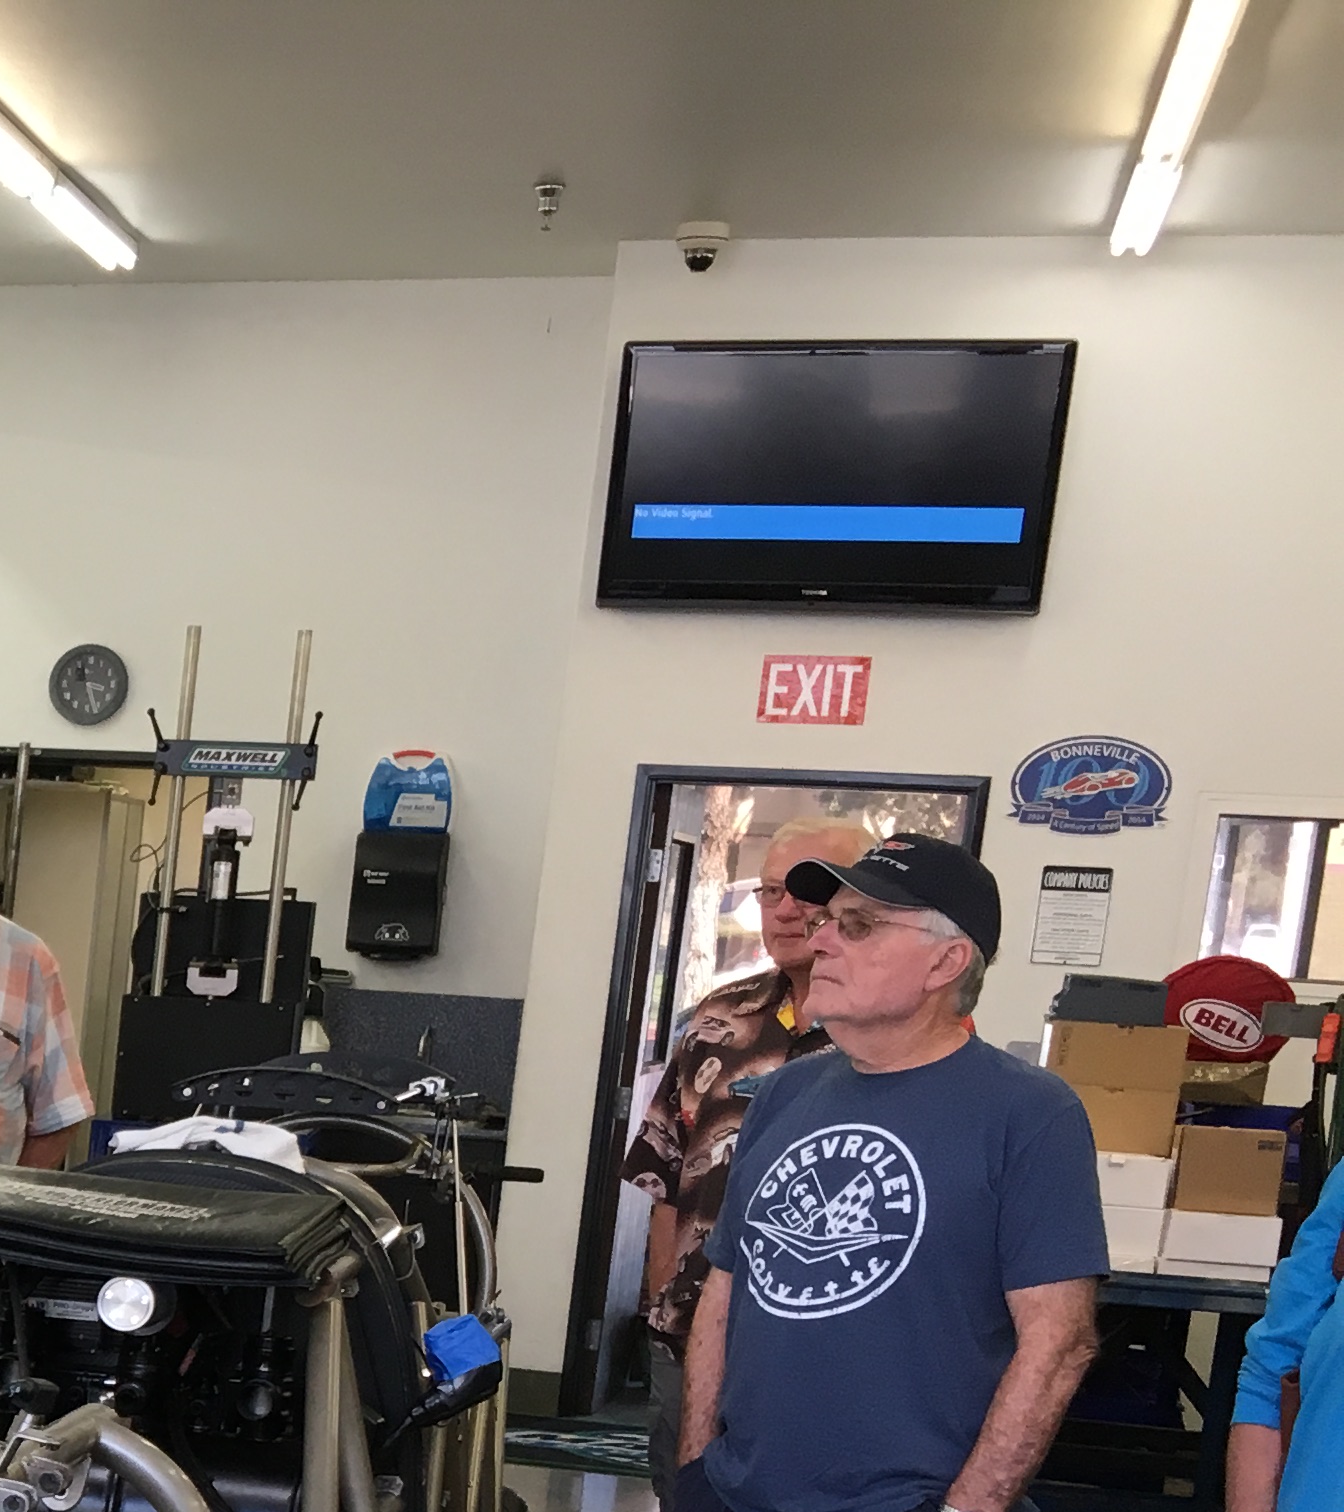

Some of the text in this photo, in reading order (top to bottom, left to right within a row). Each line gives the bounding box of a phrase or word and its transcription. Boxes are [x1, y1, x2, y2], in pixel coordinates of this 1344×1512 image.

[635, 508, 648, 518] No
[652, 508, 679, 518] Video
[765, 663, 863, 717] EXIT
[193, 750, 279, 763] MAXWELL
[1050, 744, 1141, 766] BONNEVILLE
[1044, 871, 1110, 890] COMPANY POLICIES
[1193, 1008, 1250, 1044] BELL
[761, 1135, 912, 1214] CHEVROLET
